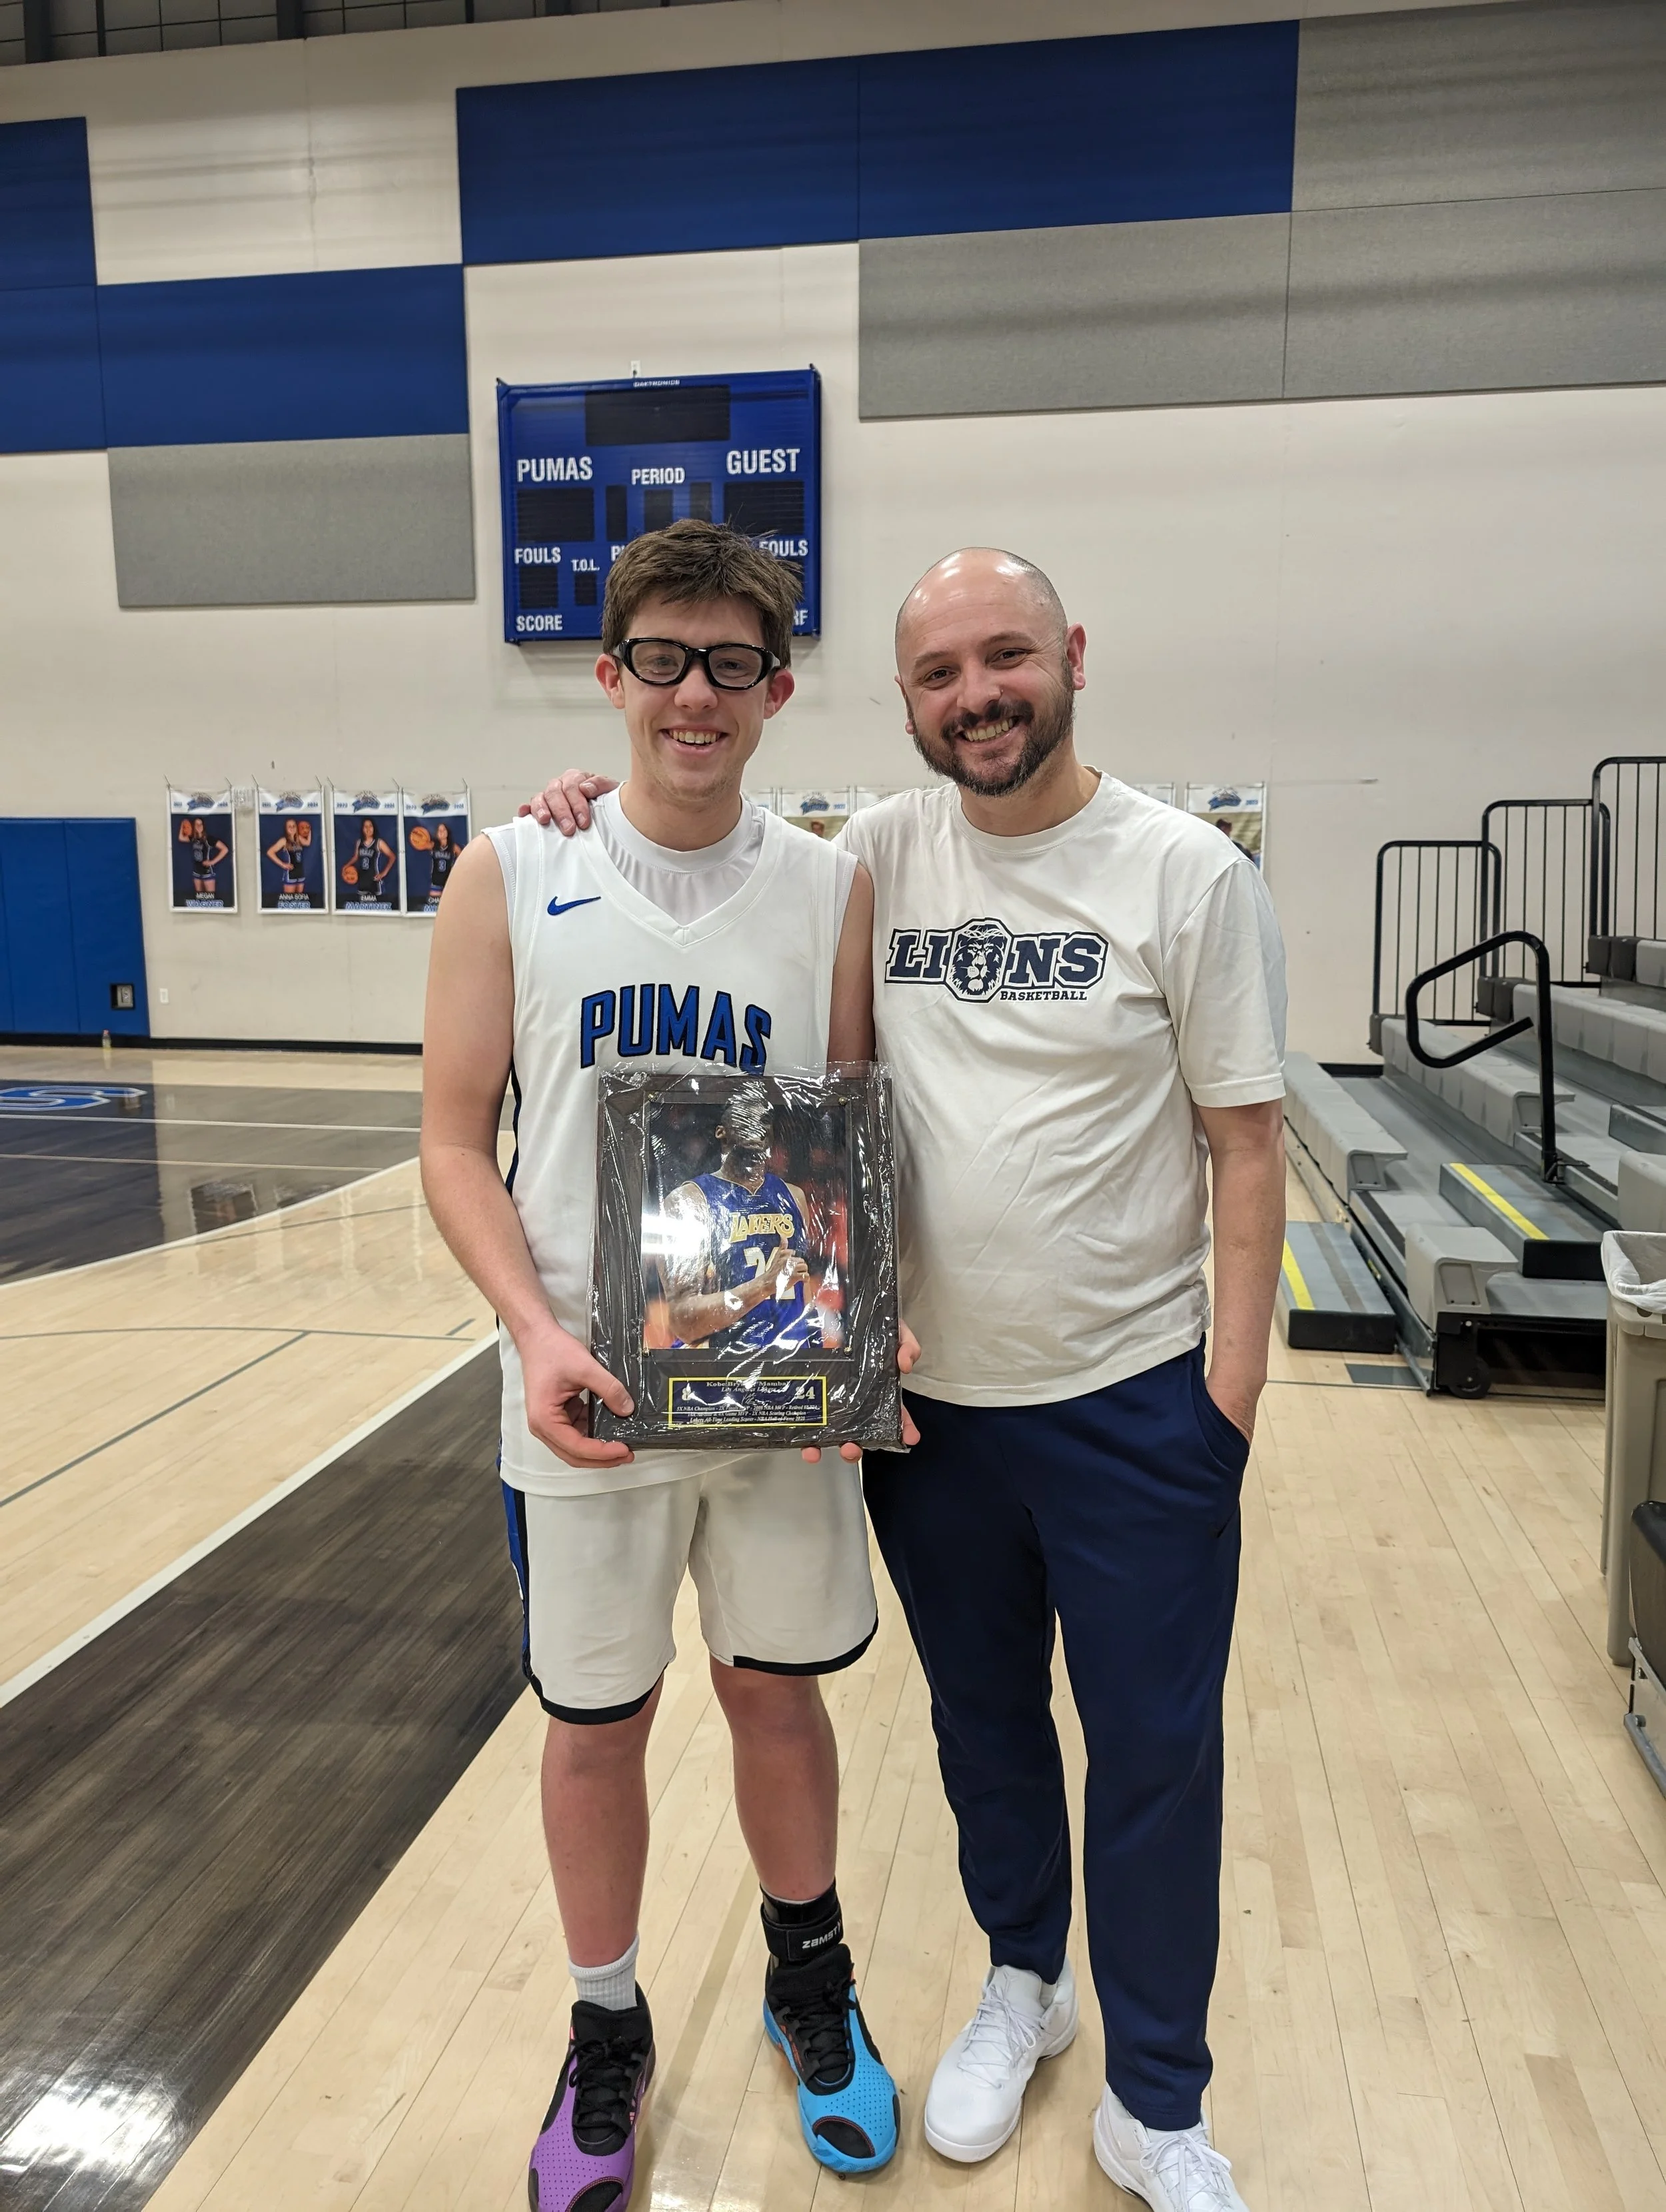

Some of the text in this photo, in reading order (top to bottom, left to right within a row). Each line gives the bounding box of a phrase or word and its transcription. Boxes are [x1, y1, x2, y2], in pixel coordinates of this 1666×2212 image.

[516, 456, 592, 482] PUMAS
[726, 448, 800, 475] GUEST
[631, 467, 685, 485] PERIOD
[514, 546, 562, 564] FOULS
[570, 559, 600, 572] T.O.L.
[516, 614, 562, 632] SCORE
[345, 901, 393, 910] MARTINEZ
[1000, 990, 1088, 1001] BASKETBALL
[580, 983, 772, 1077] PUMAS
[728, 1212, 795, 1244] LAKERS
[796, 1386, 815, 1400] 24
